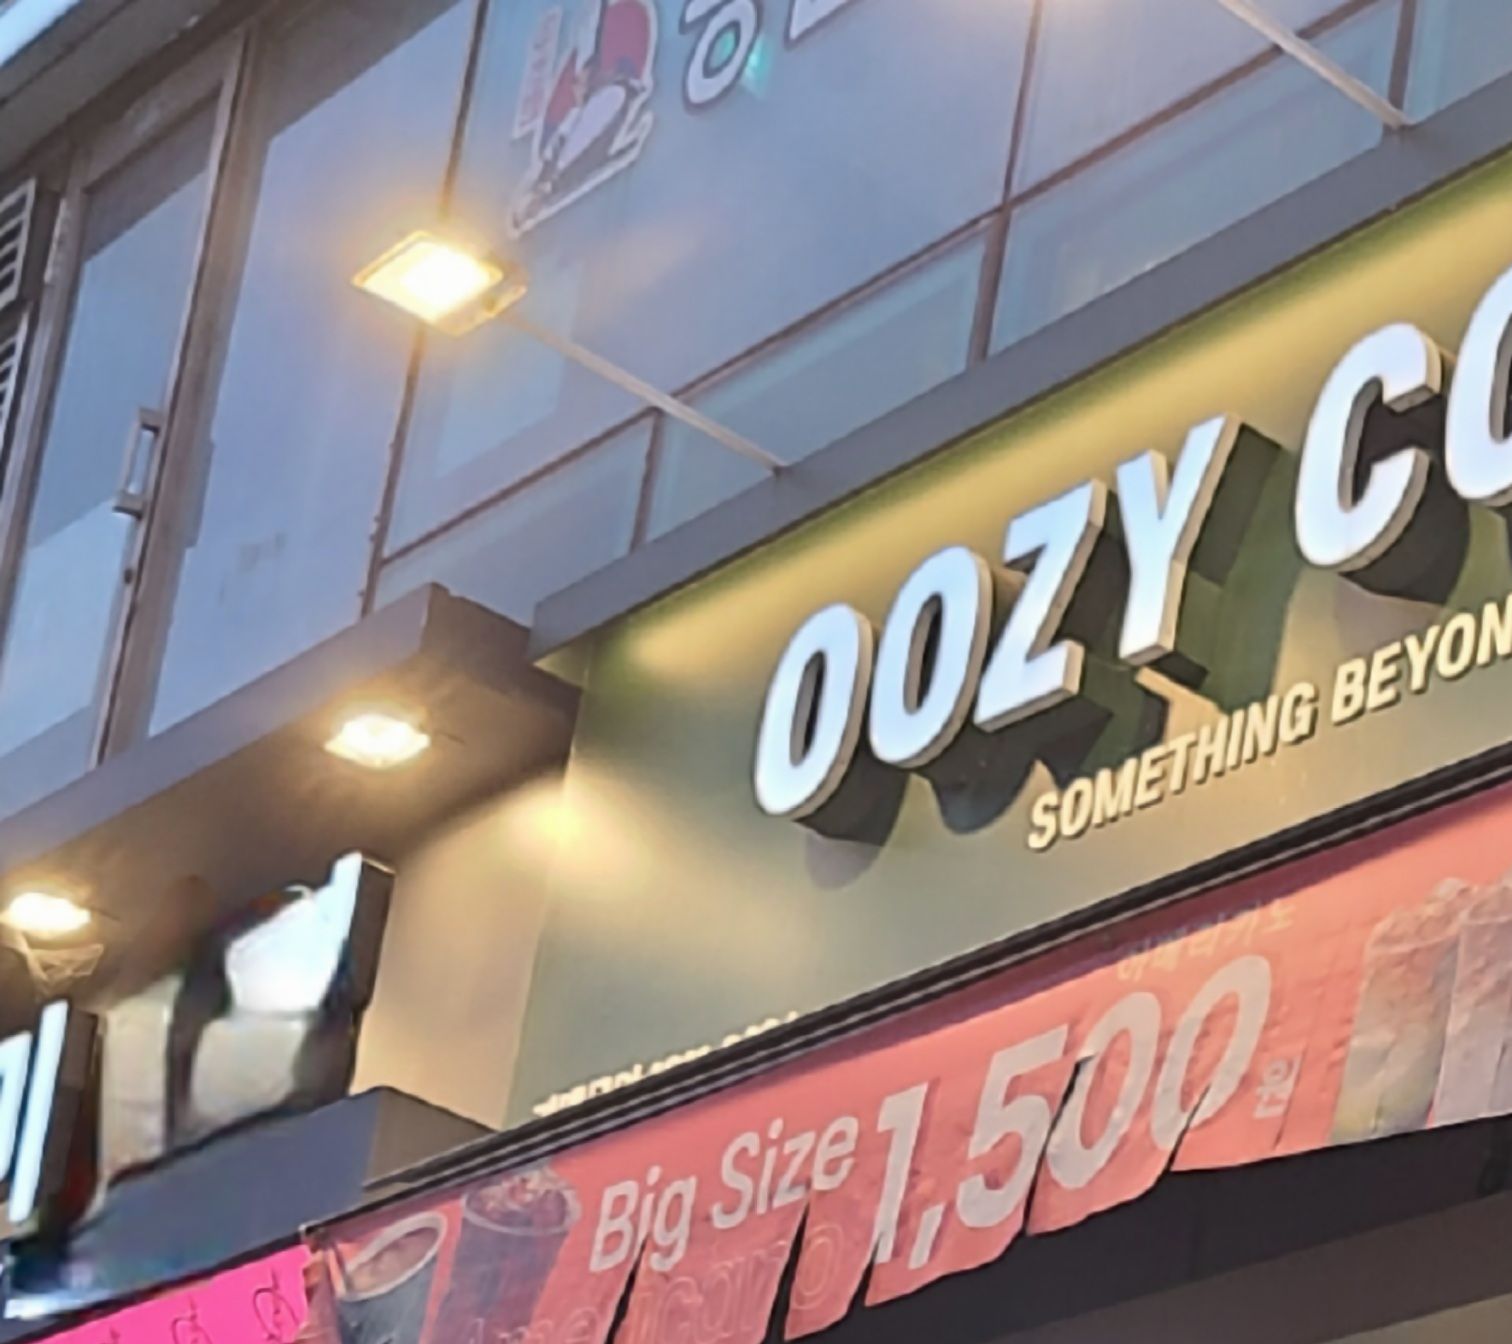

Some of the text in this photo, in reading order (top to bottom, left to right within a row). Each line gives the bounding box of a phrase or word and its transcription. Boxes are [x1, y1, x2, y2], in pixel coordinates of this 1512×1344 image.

[755, 413, 1243, 818] OOZY
[1027, 682, 1318, 851] SOMETHING
[589, 1113, 861, 1272] Big Size
[873, 955, 1272, 1270] 1,500
